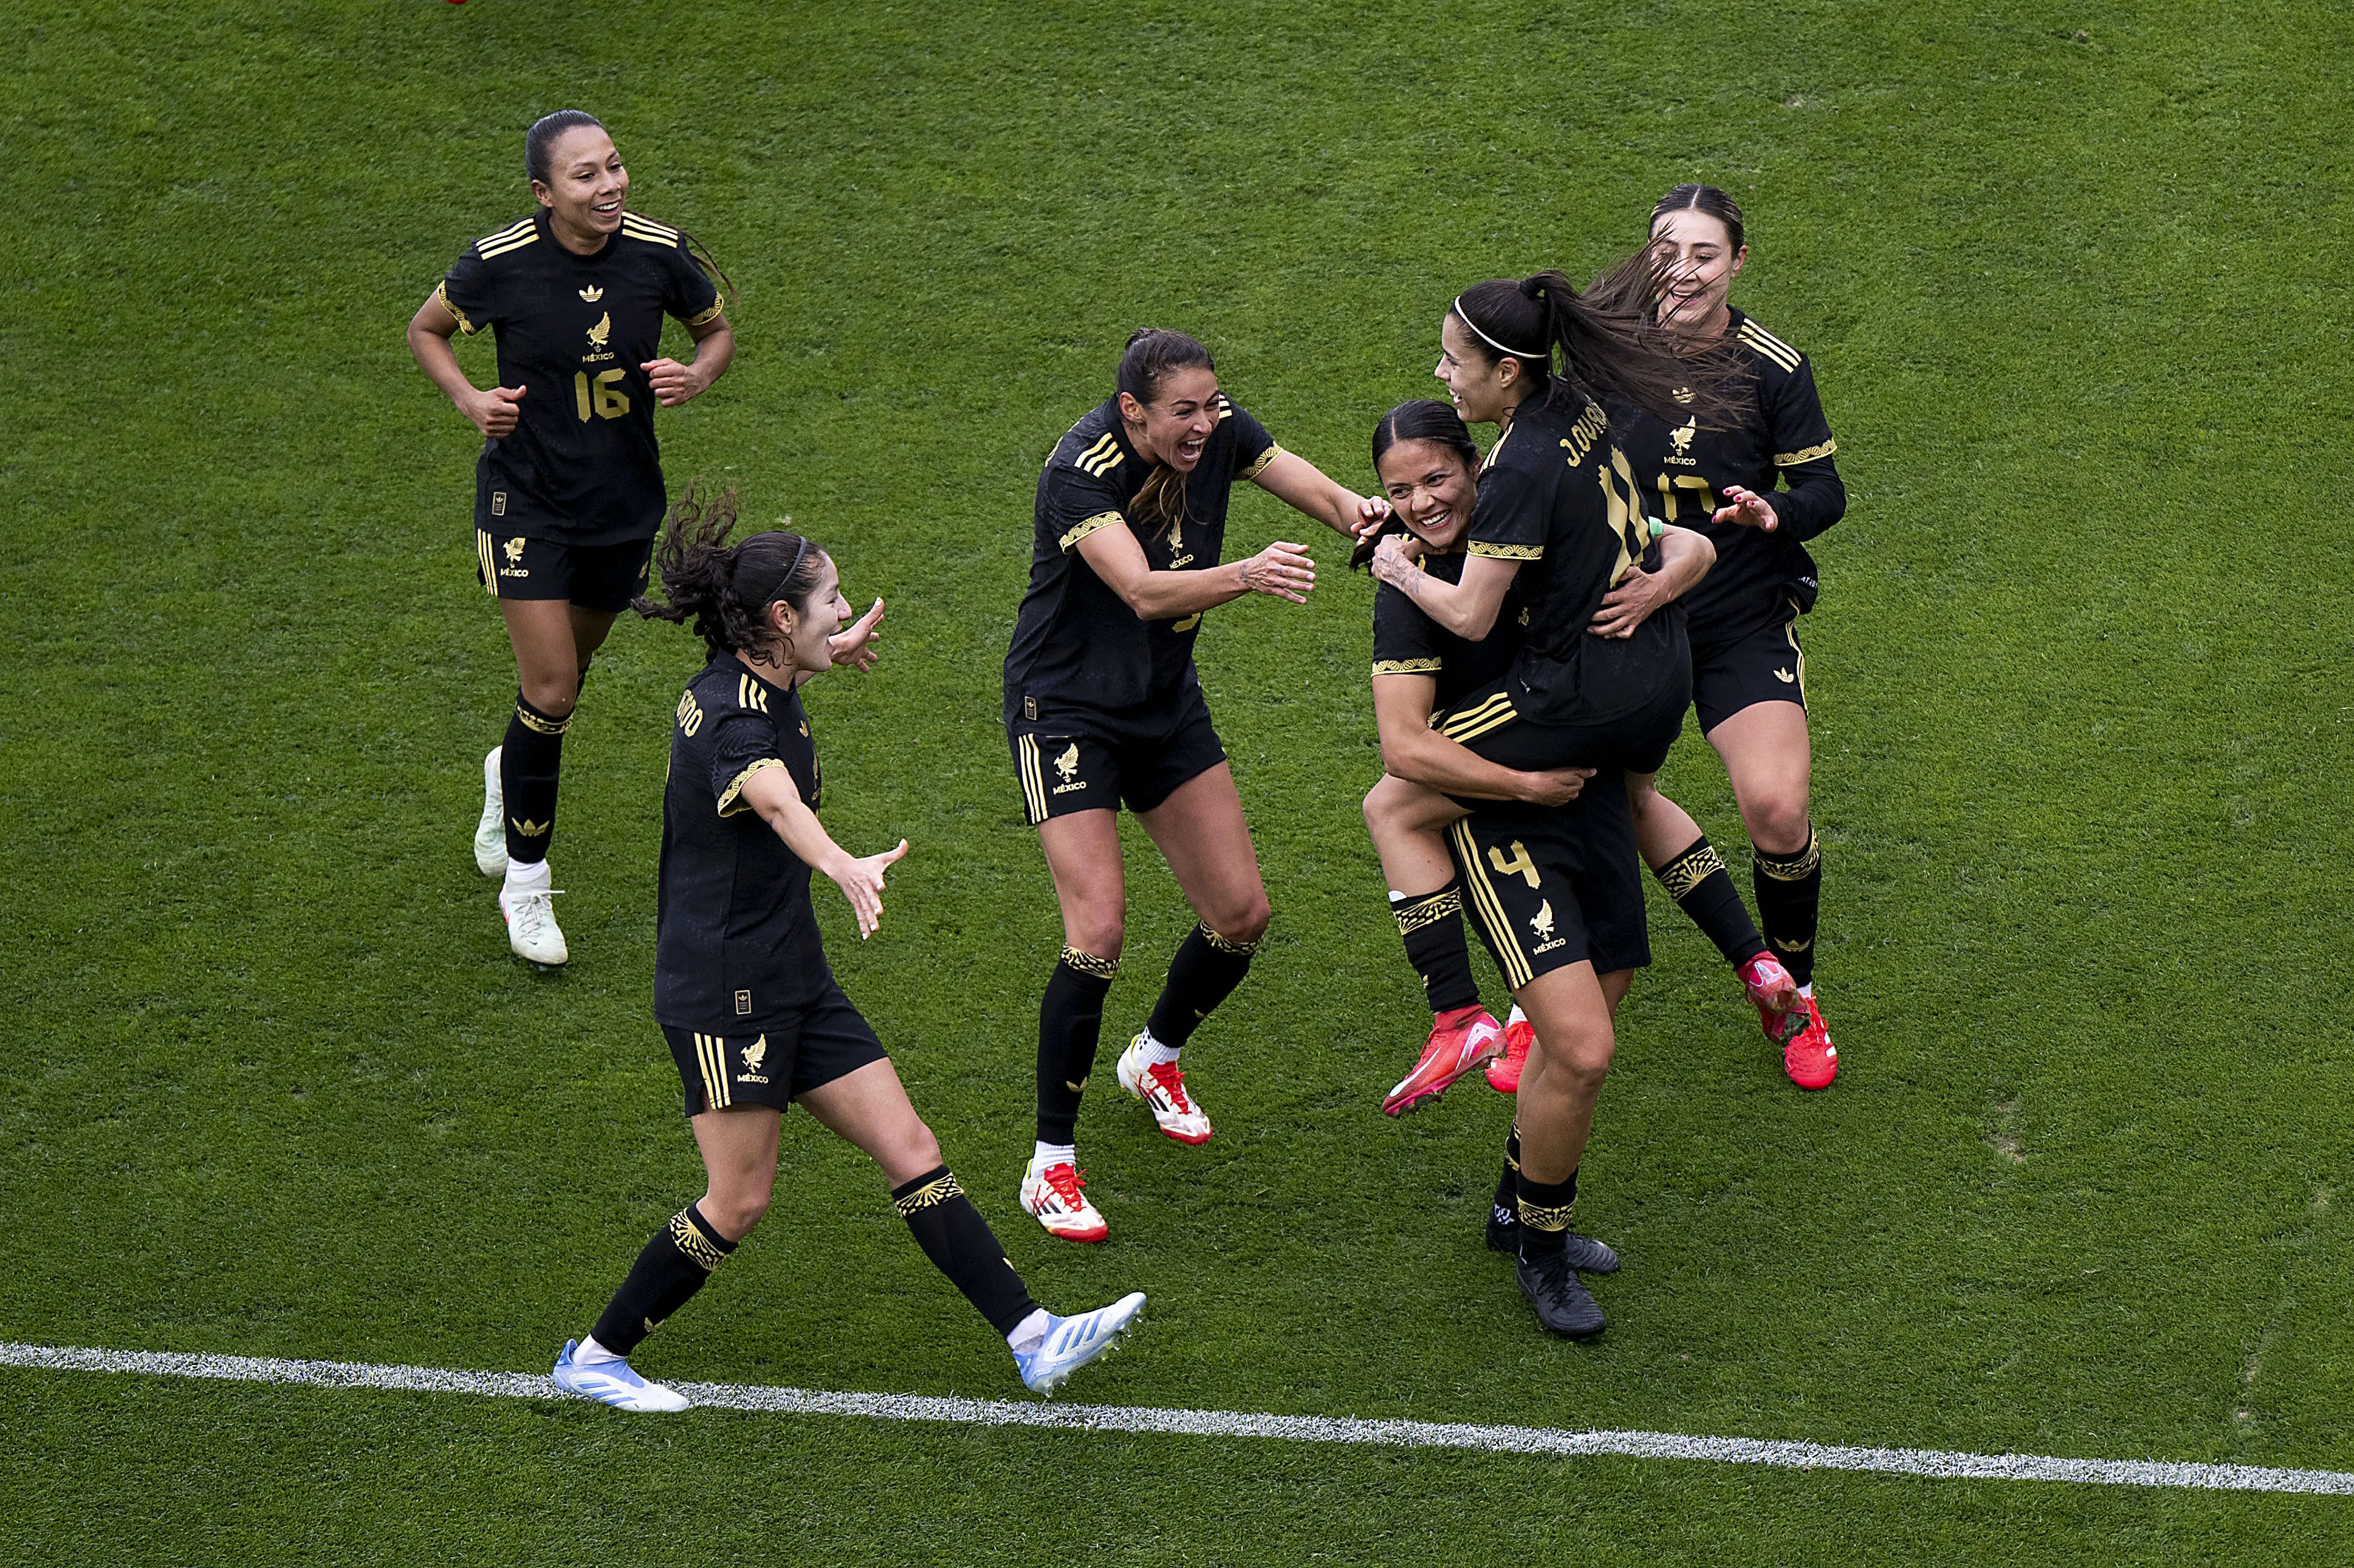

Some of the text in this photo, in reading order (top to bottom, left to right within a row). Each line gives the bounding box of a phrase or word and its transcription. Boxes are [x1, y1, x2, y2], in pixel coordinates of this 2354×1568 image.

[582, 352, 615, 363] MÉXICO
[574, 369, 630, 423] 16
[1664, 456, 1697, 466] MÉXICO
[1657, 472, 1716, 522] 17
[1598, 443, 1650, 589] 11
[1168, 553, 1194, 570] MÉXICO
[1052, 781, 1086, 795] MÉXICO
[1488, 840, 1541, 890] 4
[1532, 937, 1566, 955] MÉXICO
[736, 1072, 769, 1084] MÉXICO
